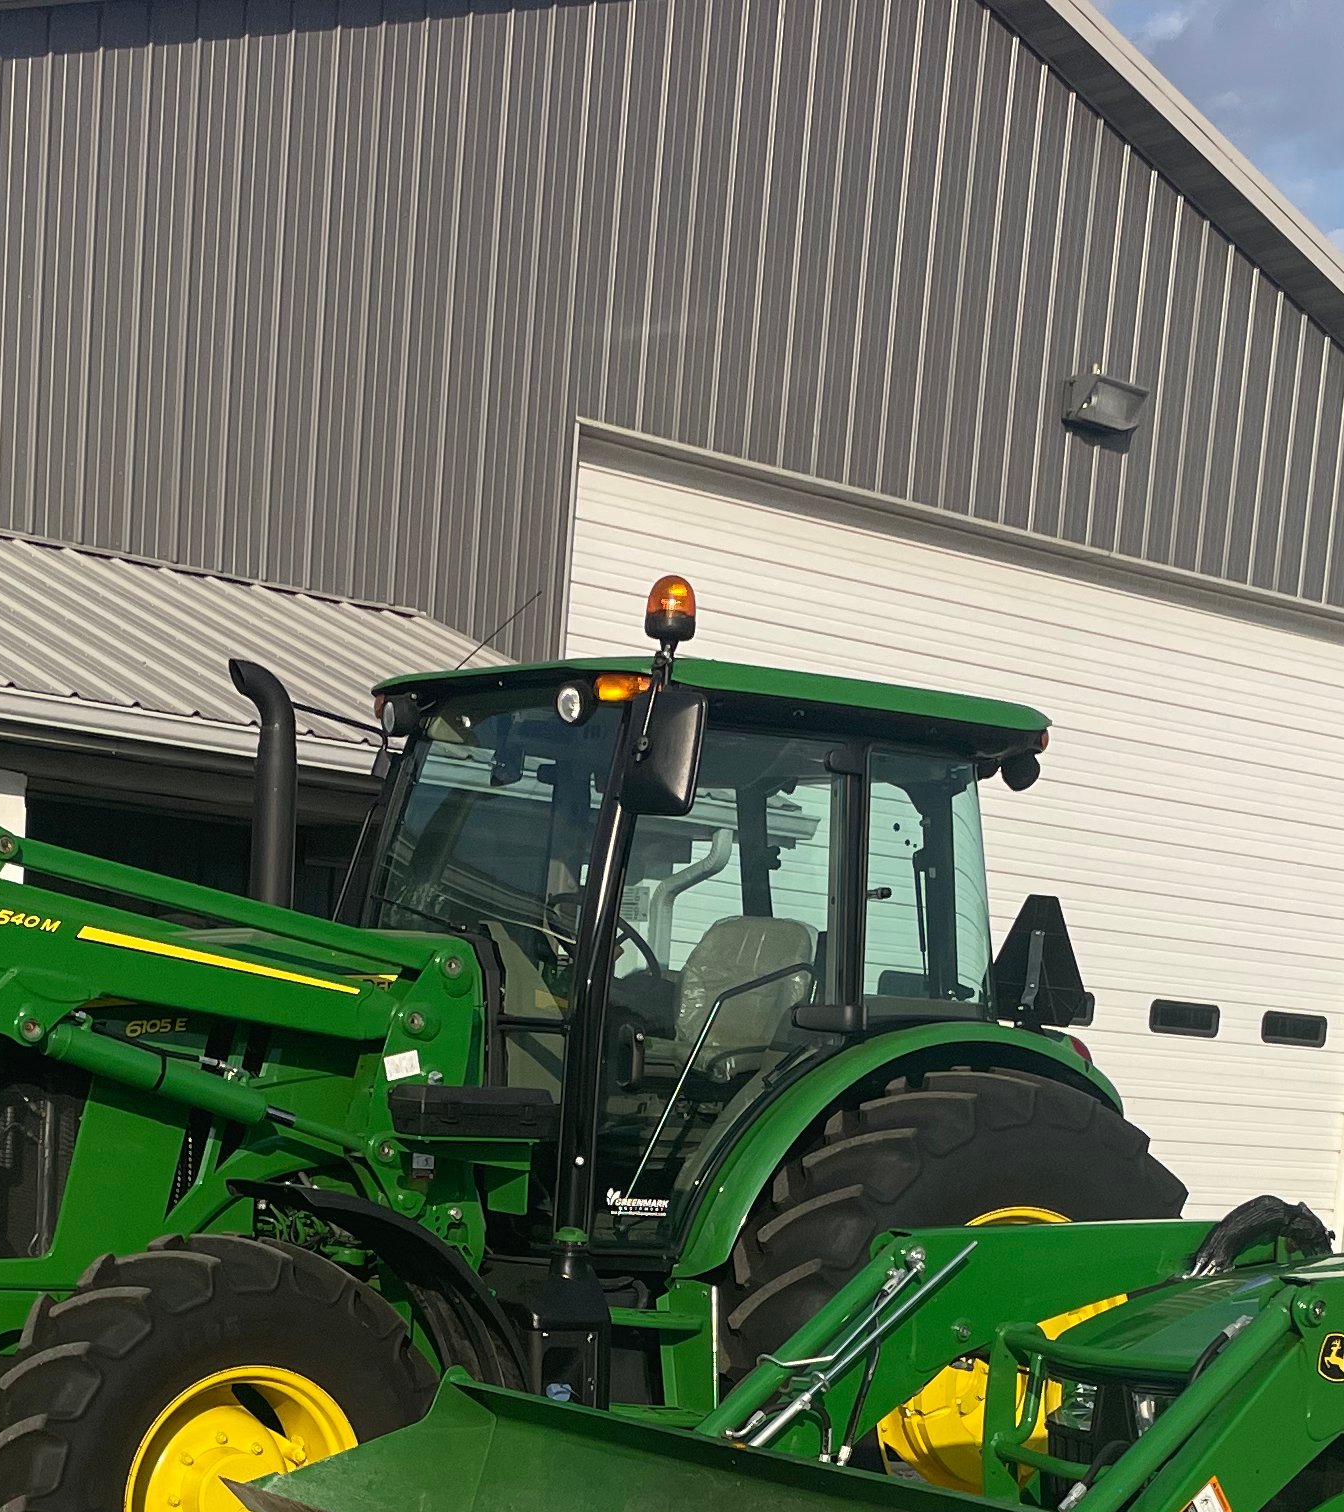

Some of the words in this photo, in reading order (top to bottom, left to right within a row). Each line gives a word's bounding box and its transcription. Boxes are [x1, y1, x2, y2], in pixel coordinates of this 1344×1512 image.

[40, 917, 62, 933] M
[125, 1019, 172, 1037] 6105
[174, 1018, 189, 1032] E
